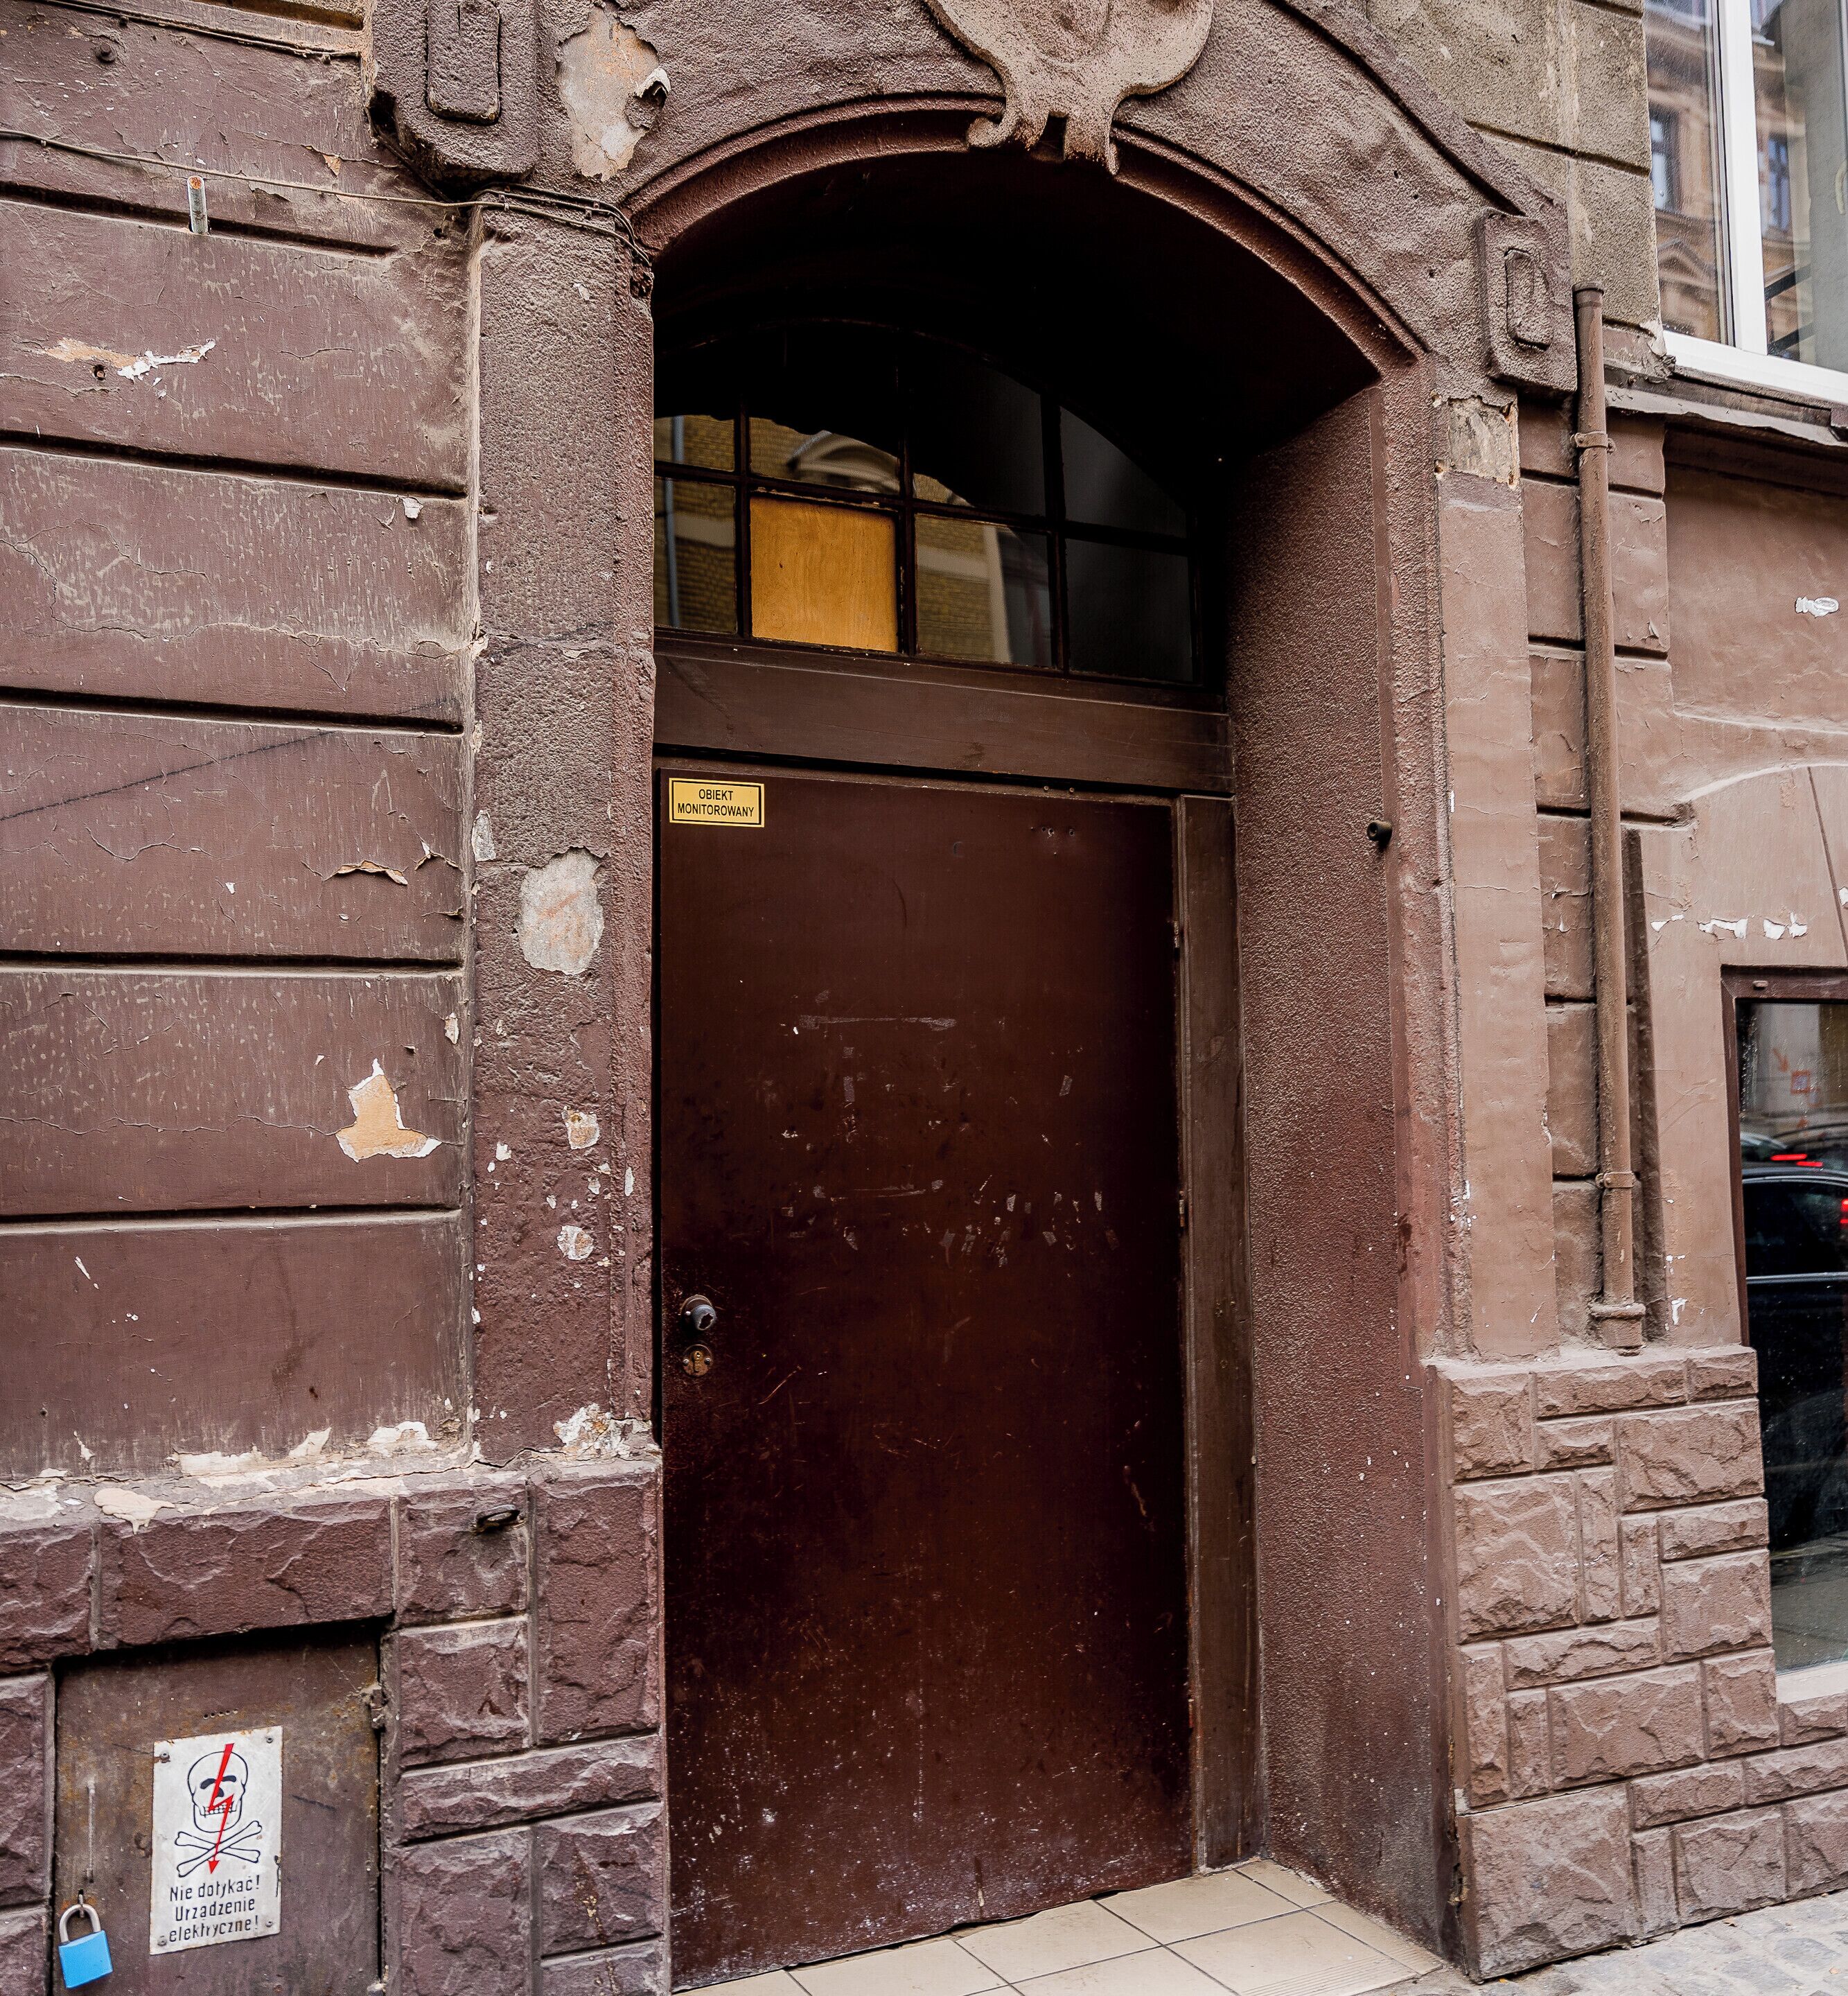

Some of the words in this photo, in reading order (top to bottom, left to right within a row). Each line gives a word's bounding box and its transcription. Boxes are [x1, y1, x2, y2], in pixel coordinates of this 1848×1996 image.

[698, 789, 734, 800] OBIEKT
[677, 803, 755, 817] MONITOROWANY
[170, 1885, 193, 1902] Nie
[198, 1875, 260, 1898] dotykać!
[175, 1896, 255, 1921] Urządzenie
[169, 1915, 258, 1943] elektryczne!
